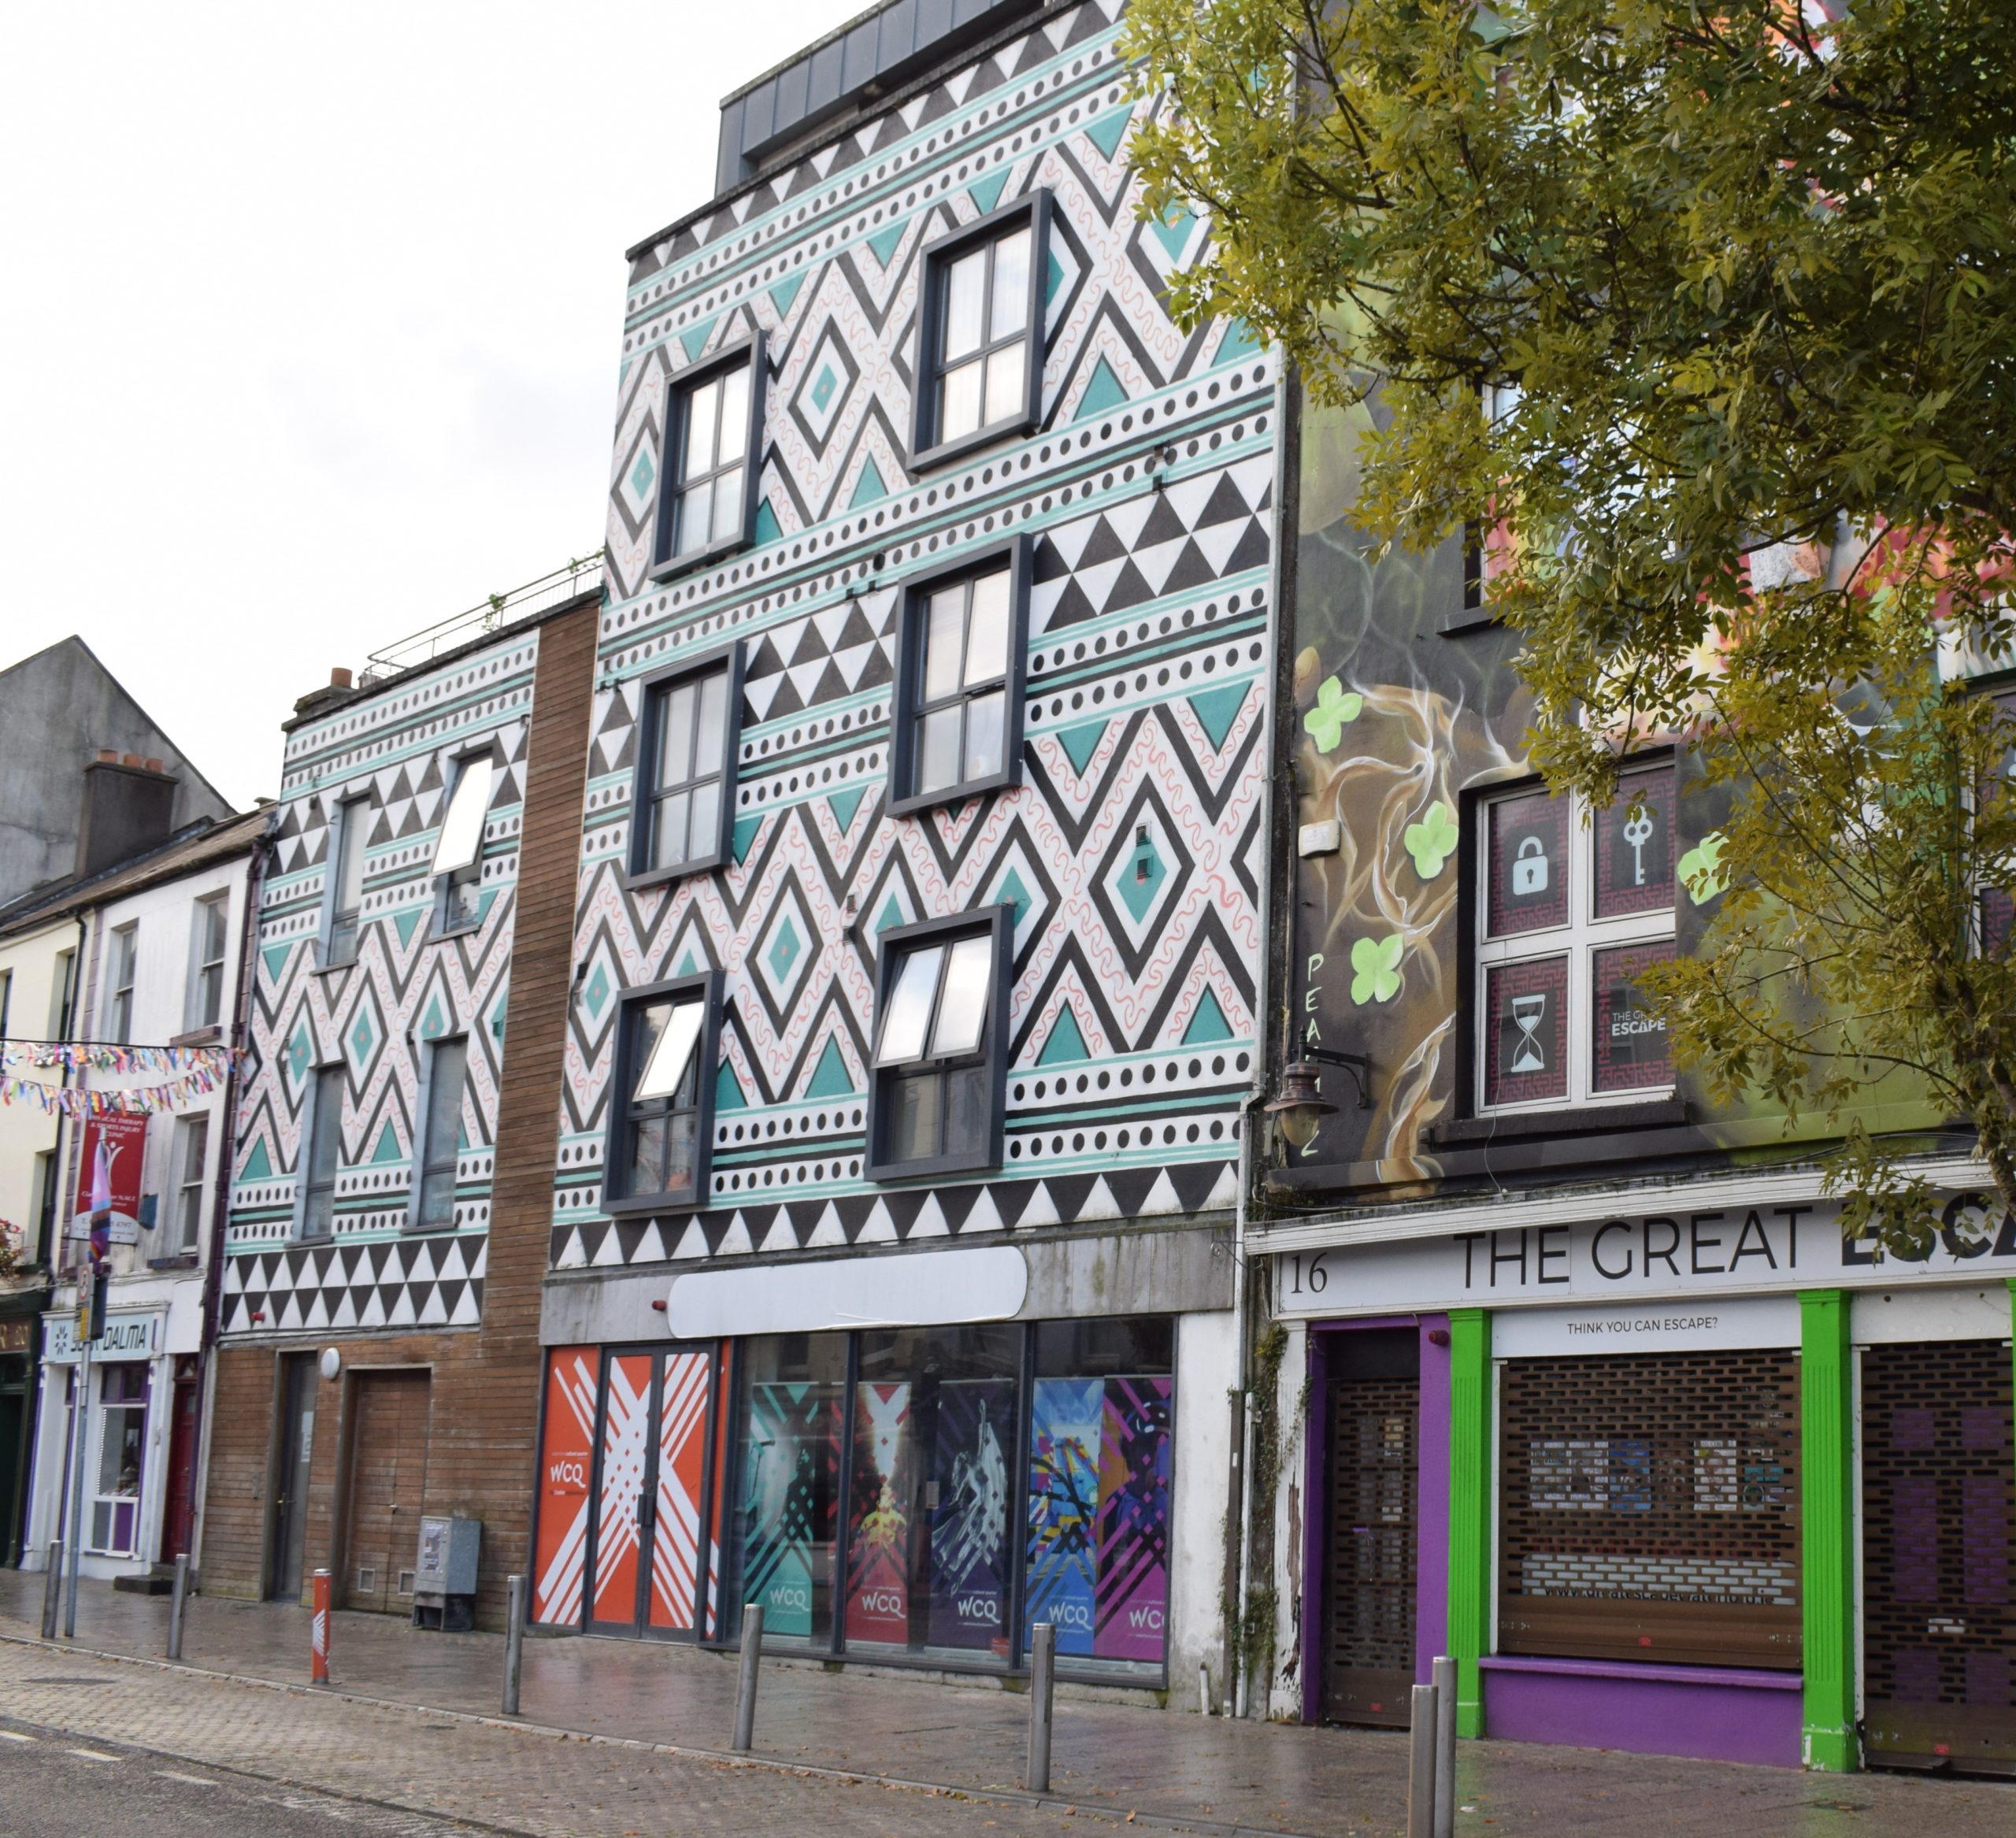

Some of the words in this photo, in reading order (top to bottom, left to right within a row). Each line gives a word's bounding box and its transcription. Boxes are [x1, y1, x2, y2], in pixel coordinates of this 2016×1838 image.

[1612, 1017, 1666, 1036] ESCAPE
[1613, 1011, 1632, 1022] THE
[1454, 1225, 1569, 1288] THE
[1592, 1206, 1813, 1280] GREAT
[1291, 1252, 1328, 1294] 16
[103, 1324, 146, 1351] DALMA
[1567, 1322, 1603, 1335] THINK
[1606, 1321, 1632, 1333] YOU
[1634, 1320, 1661, 1332] CAN
[1664, 1317, 1718, 1331] ESCAPE?
[550, 1460, 587, 1488] WCQ
[769, 1586, 810, 1612] WCQ
[862, 1591, 906, 1619] WCQ
[958, 1595, 1001, 1625] WCQ
[1049, 1602, 1092, 1631] WCQ
